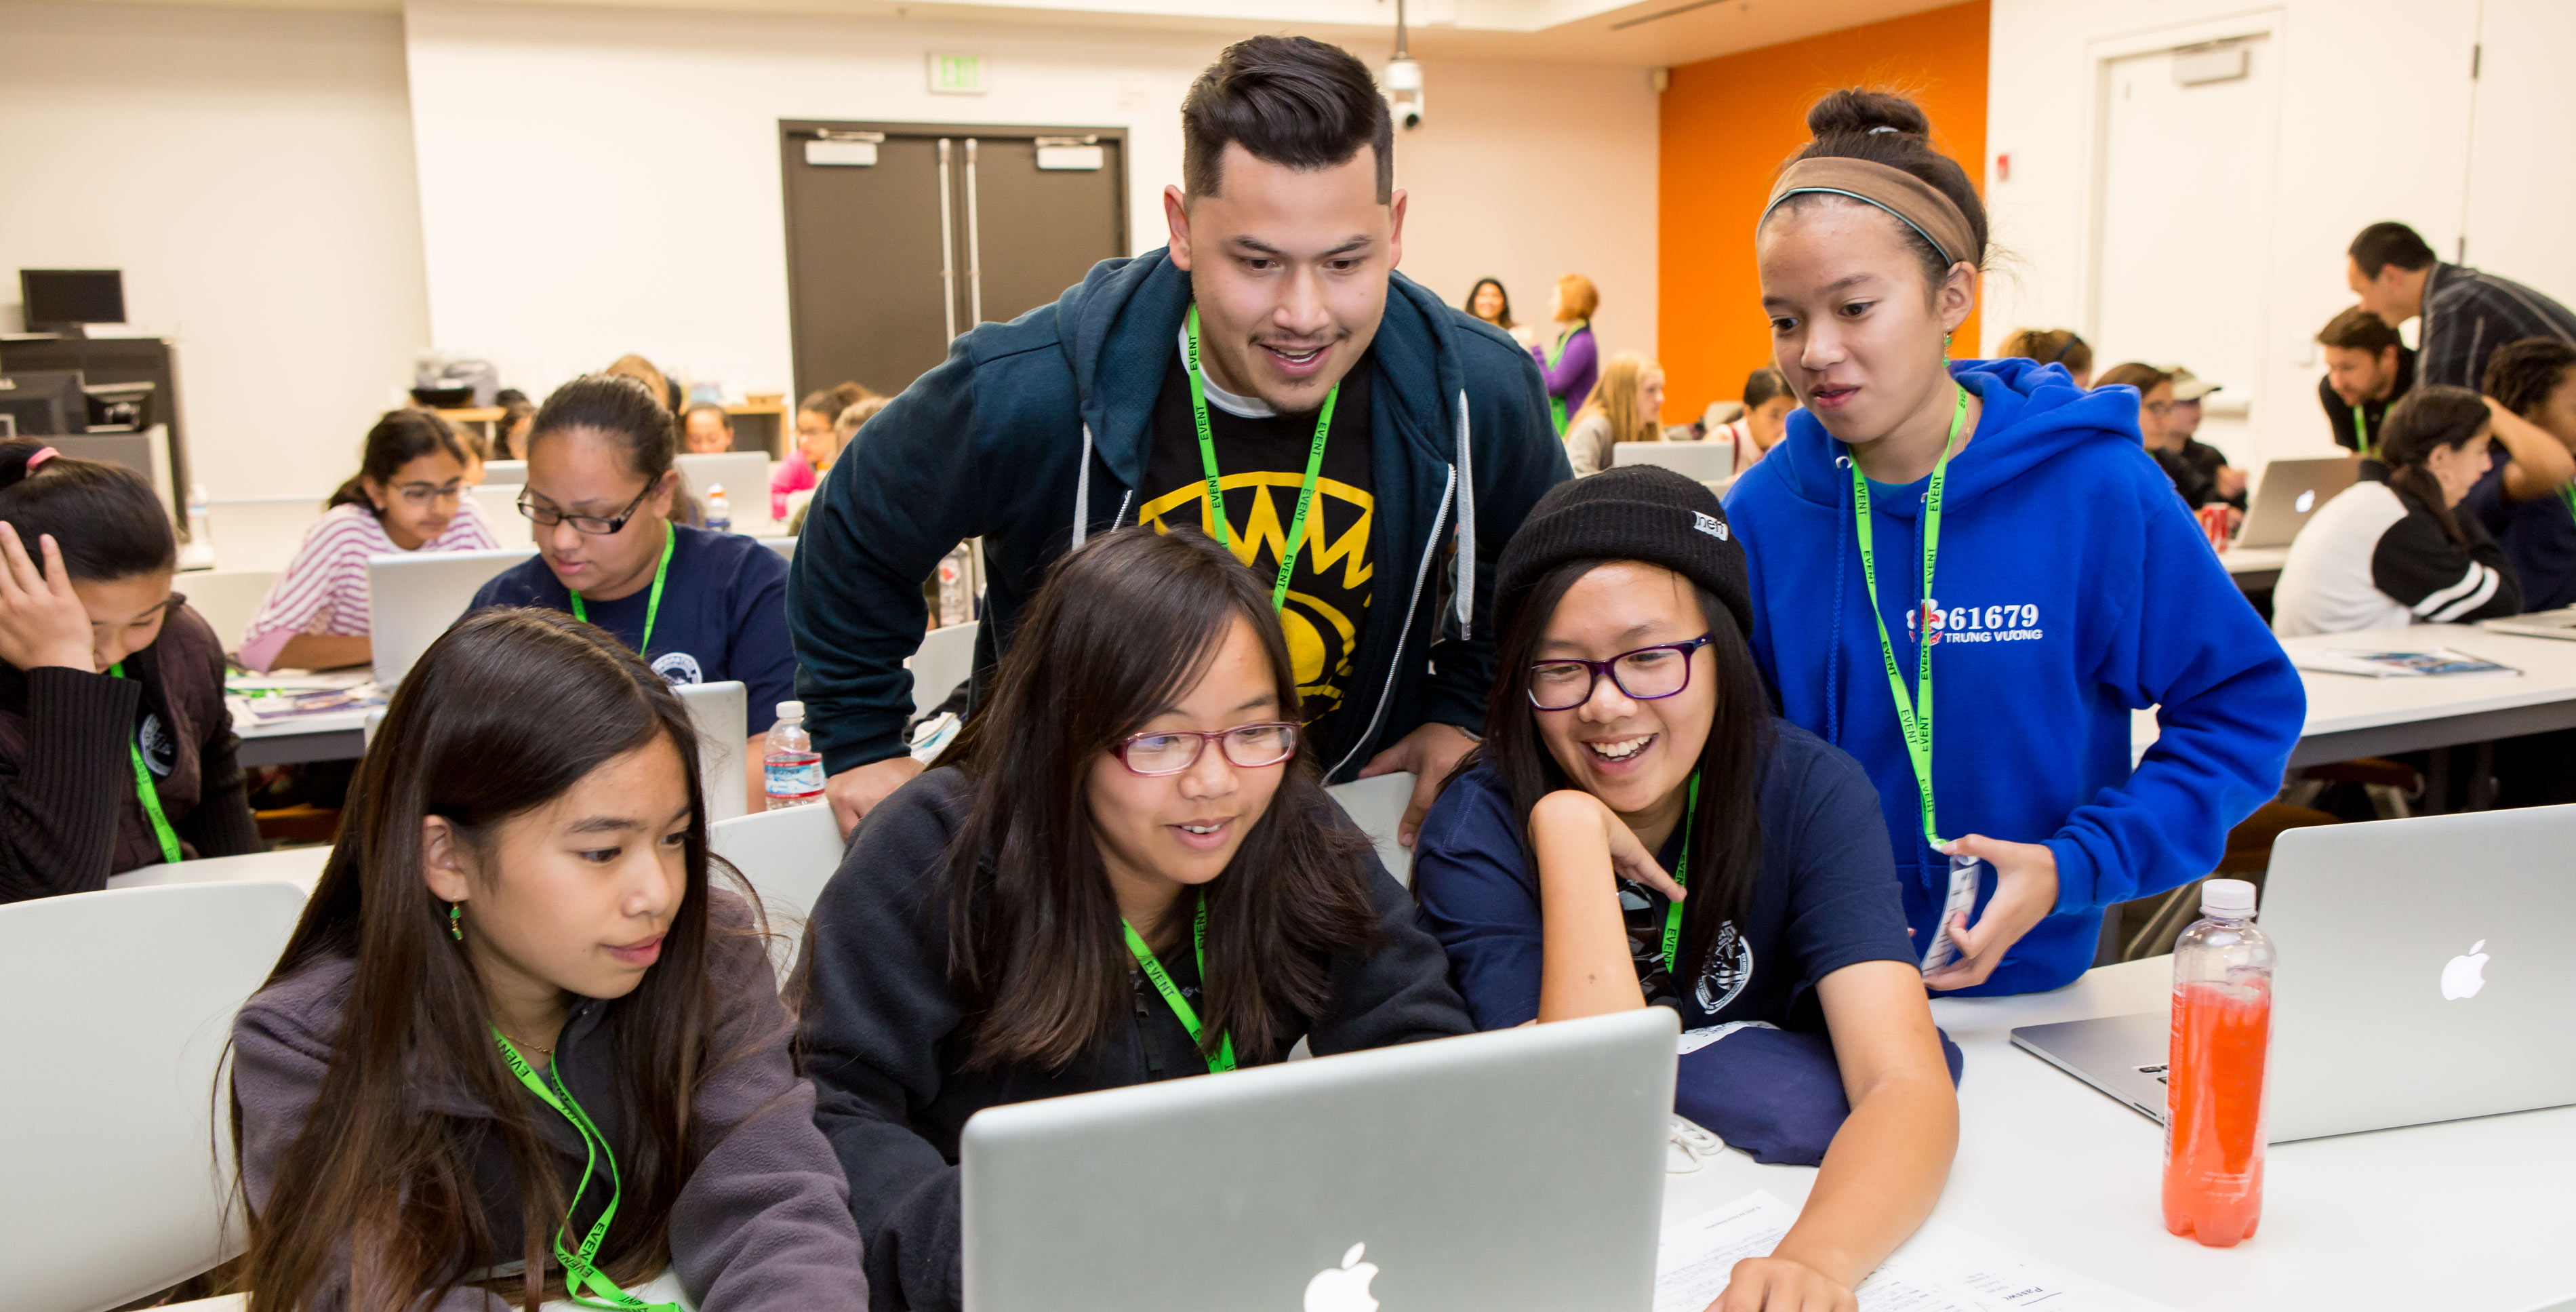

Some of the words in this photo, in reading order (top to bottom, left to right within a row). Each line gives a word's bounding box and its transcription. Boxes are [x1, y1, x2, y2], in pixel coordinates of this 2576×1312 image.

[1189, 336, 1197, 371] EVENT
[1196, 405, 1209, 440] EVENT
[1312, 422, 1327, 457] EVENT
[1207, 474, 1221, 509] EVENT
[1295, 488, 1311, 523] EVENT
[1856, 482, 1868, 515] EVENT
[1929, 476, 1941, 512] EVENT
[1697, 515, 1724, 534] neff
[1277, 554, 1293, 589] EVENT
[1864, 550, 1874, 584] EVENT
[1926, 548, 1935, 584] EVENT
[1949, 603, 2039, 631] 61679
[1882, 641, 1897, 676] EVENT
[1901, 709, 1918, 744] EVENT
[1919, 716, 1929, 752] EVENT
[1920, 779, 1935, 813] EVENT
[1676, 854, 1685, 885] EVEN
[1196, 910, 1206, 950] EVENT
[1664, 928, 1676, 965] EVENT
[1144, 960, 1175, 997] EVENT
[497, 1039, 530, 1077] EVENT
[579, 1222, 605, 1263] EVEN
[556, 1252, 595, 1278] EVENT
[618, 1296, 643, 1306] ENT
